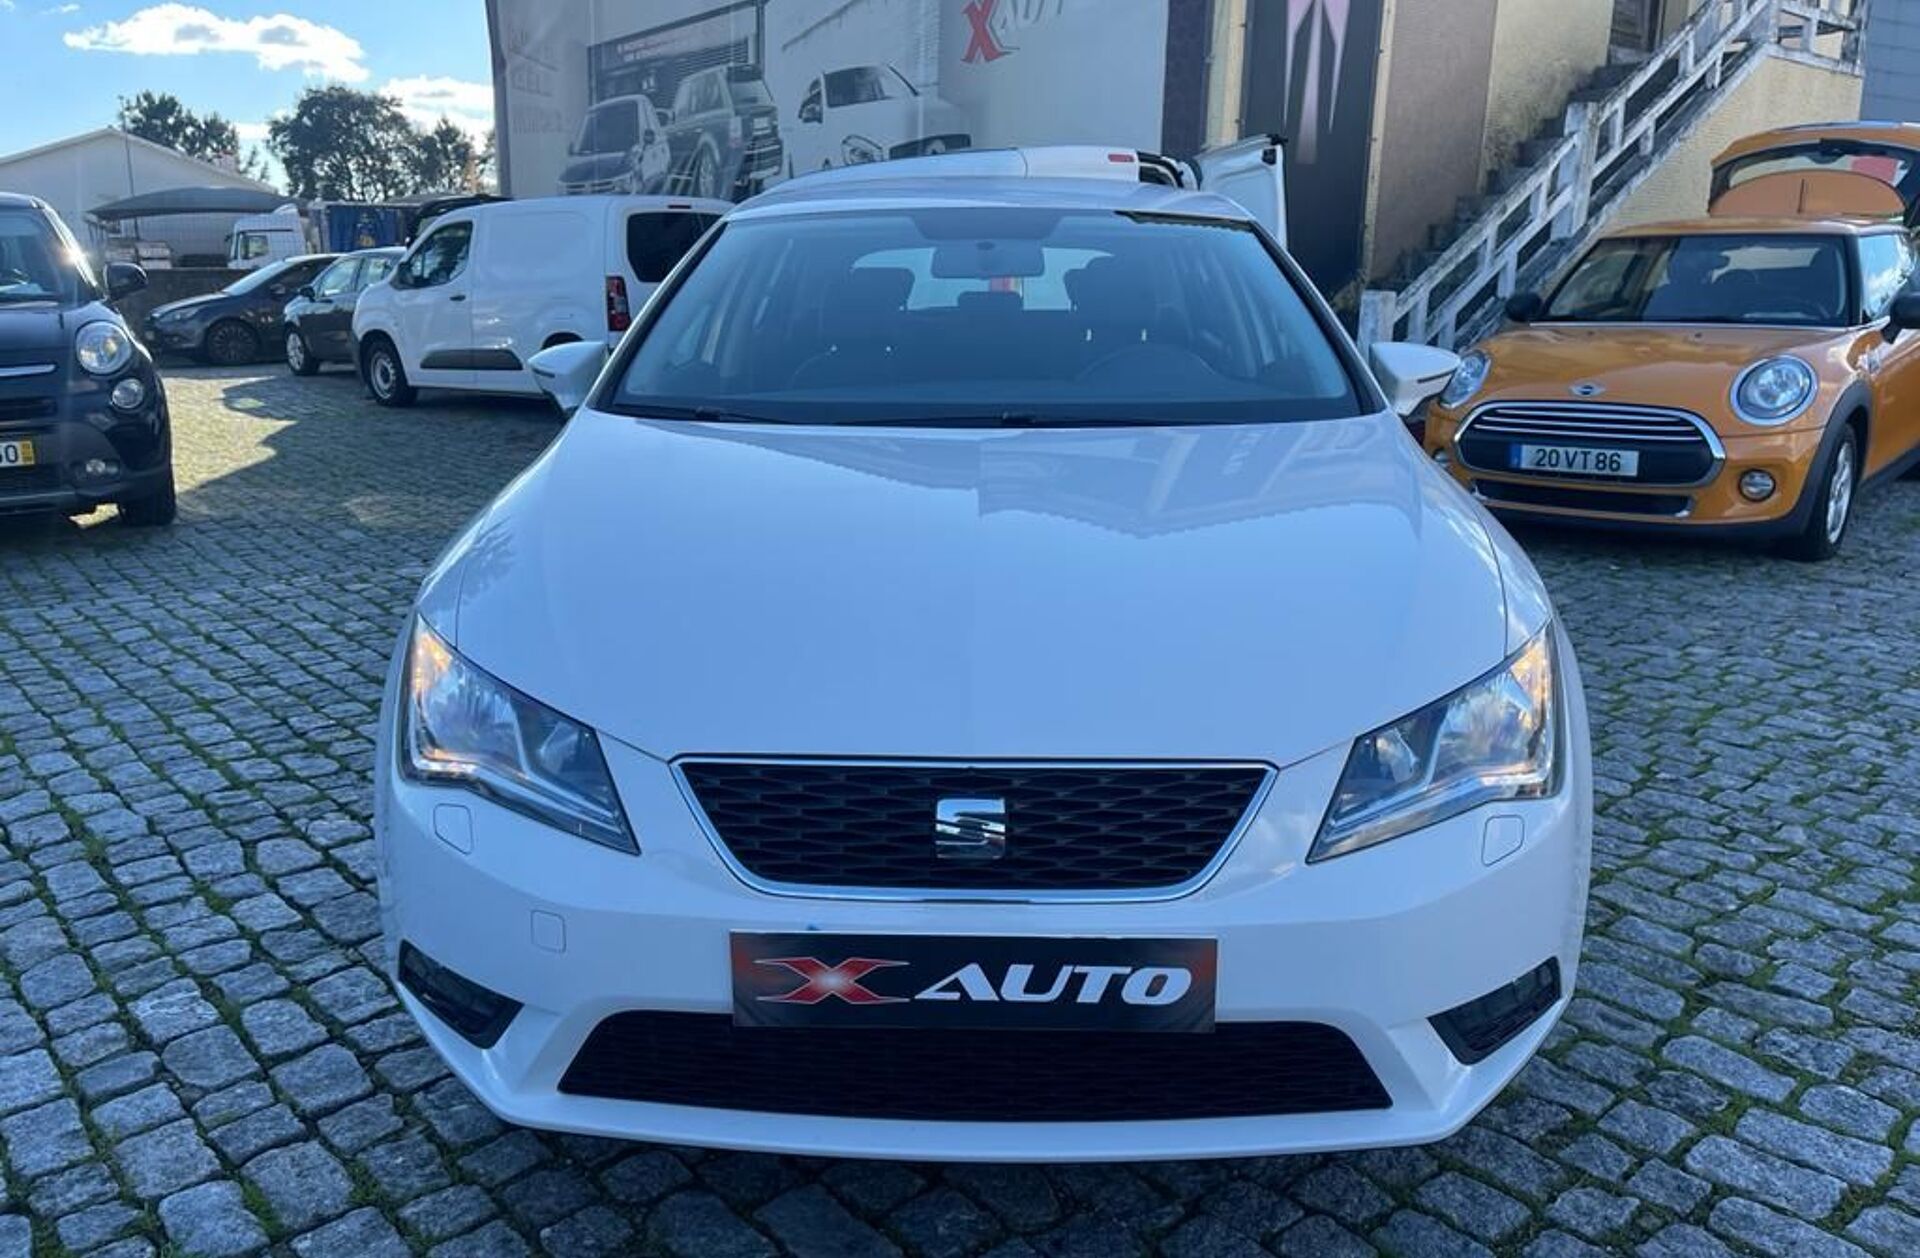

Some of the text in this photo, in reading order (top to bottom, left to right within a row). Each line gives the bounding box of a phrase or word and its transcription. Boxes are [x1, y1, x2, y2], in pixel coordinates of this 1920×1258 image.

[1535, 448, 1622, 473] 20 VT 86
[914, 962, 1192, 1005] AUTO
